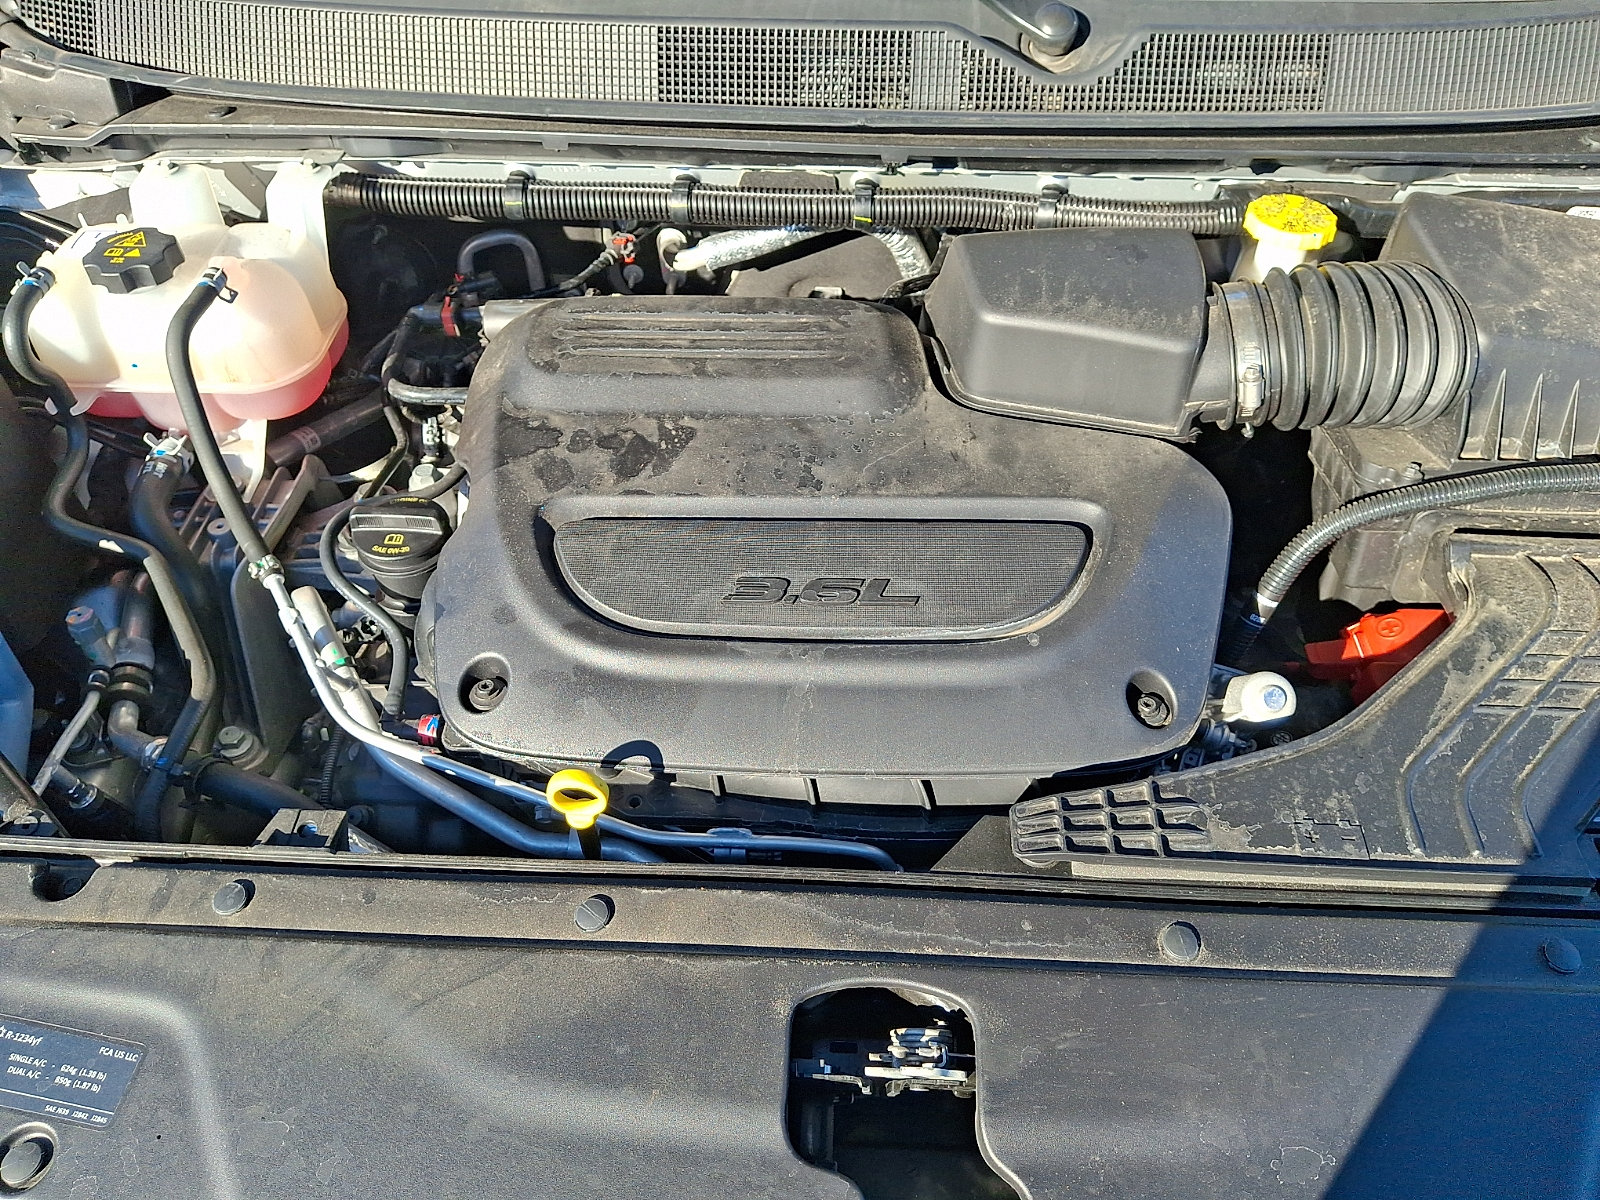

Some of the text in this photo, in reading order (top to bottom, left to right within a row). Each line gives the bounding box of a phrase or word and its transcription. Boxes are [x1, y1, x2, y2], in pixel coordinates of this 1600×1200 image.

[721, 576, 921, 606] 3.6L
[5, 1030, 43, 1046] R-1234yf
[99, 1046, 139, 1062] FCA US LLC
[9, 1053, 34, 1064] SINGLE
[32, 1059, 47, 1068] A/C
[96, 1071, 107, 1081] lb)
[7, 1065, 27, 1076] DUAL
[26, 1070, 41, 1079] A/C
[90, 1083, 101, 1093] lb)
[45, 1104, 57, 1112] SAE
